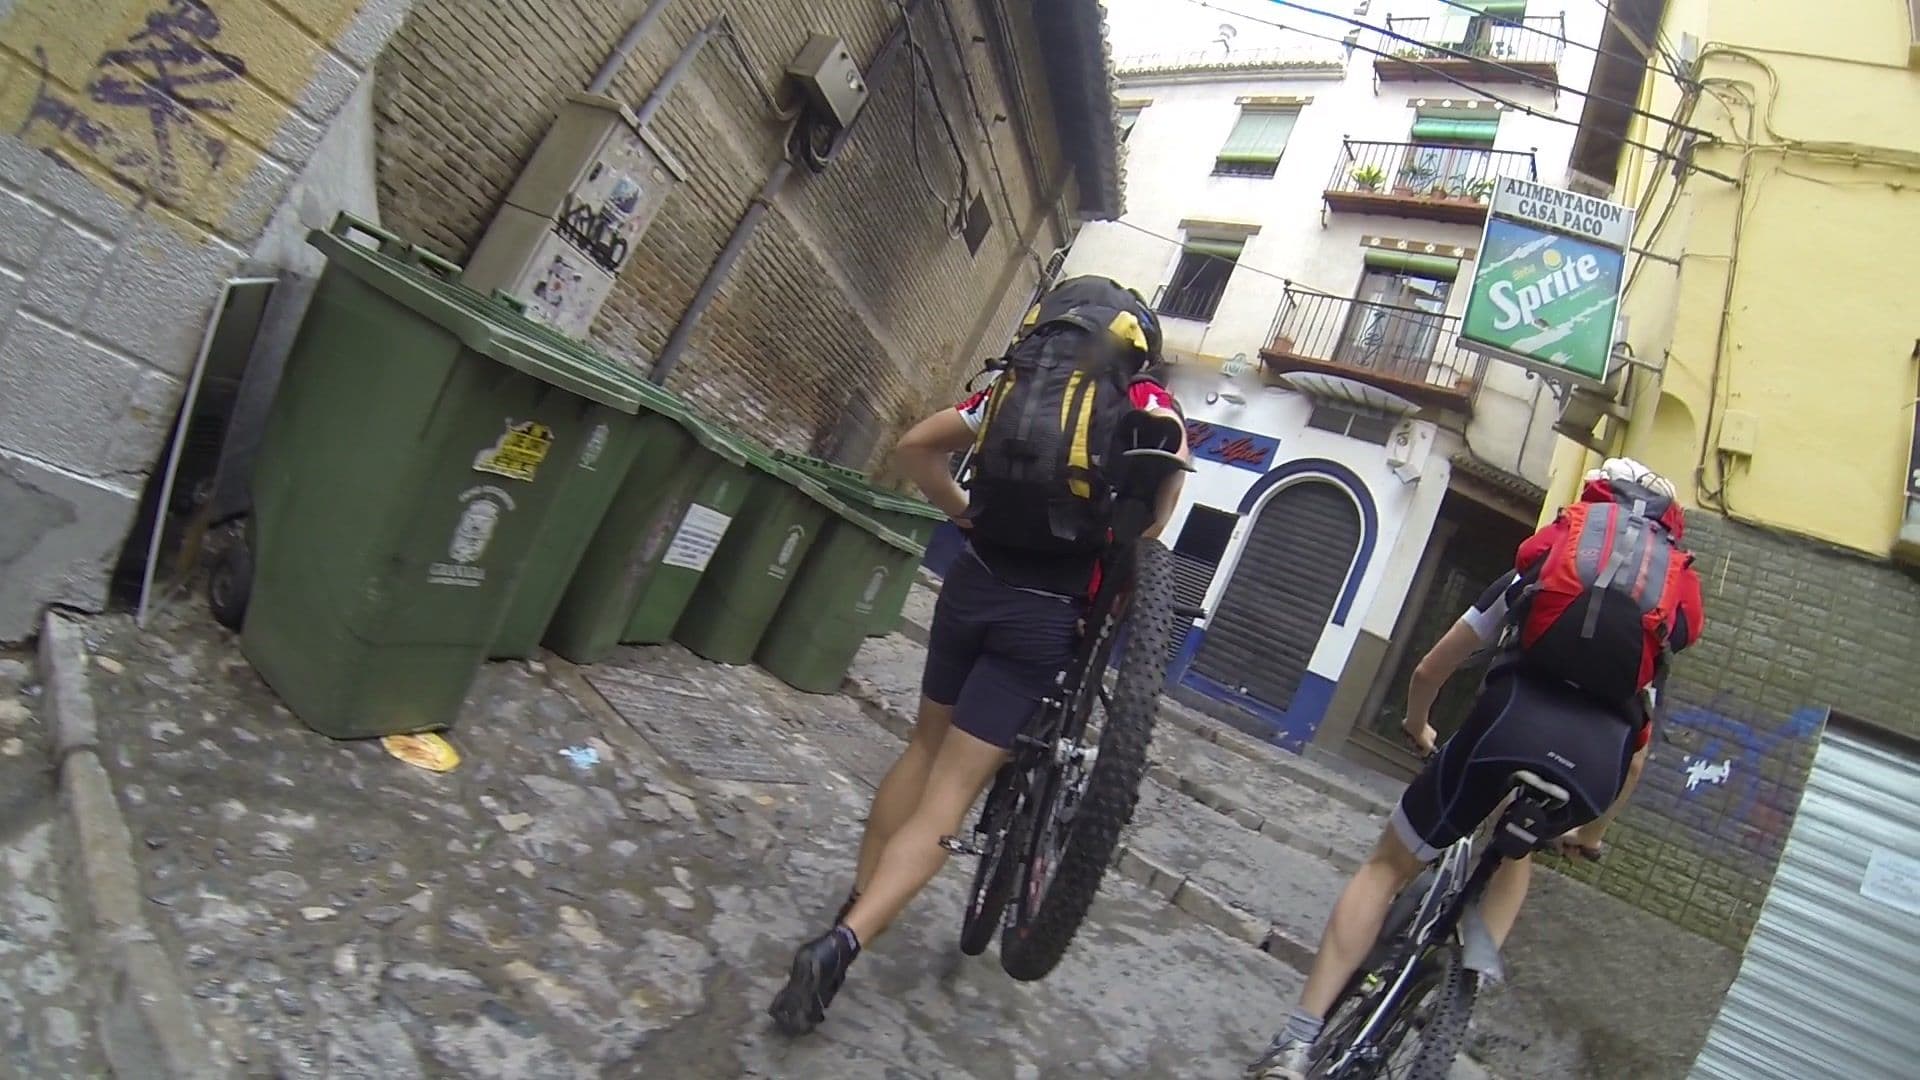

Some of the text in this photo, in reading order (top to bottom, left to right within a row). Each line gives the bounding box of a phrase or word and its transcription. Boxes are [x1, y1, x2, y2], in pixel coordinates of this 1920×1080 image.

[1505, 180, 1623, 223] ALIMENTACION
[1518, 199, 1603, 236] CASA PACO
[1488, 250, 1600, 331] Sprite
